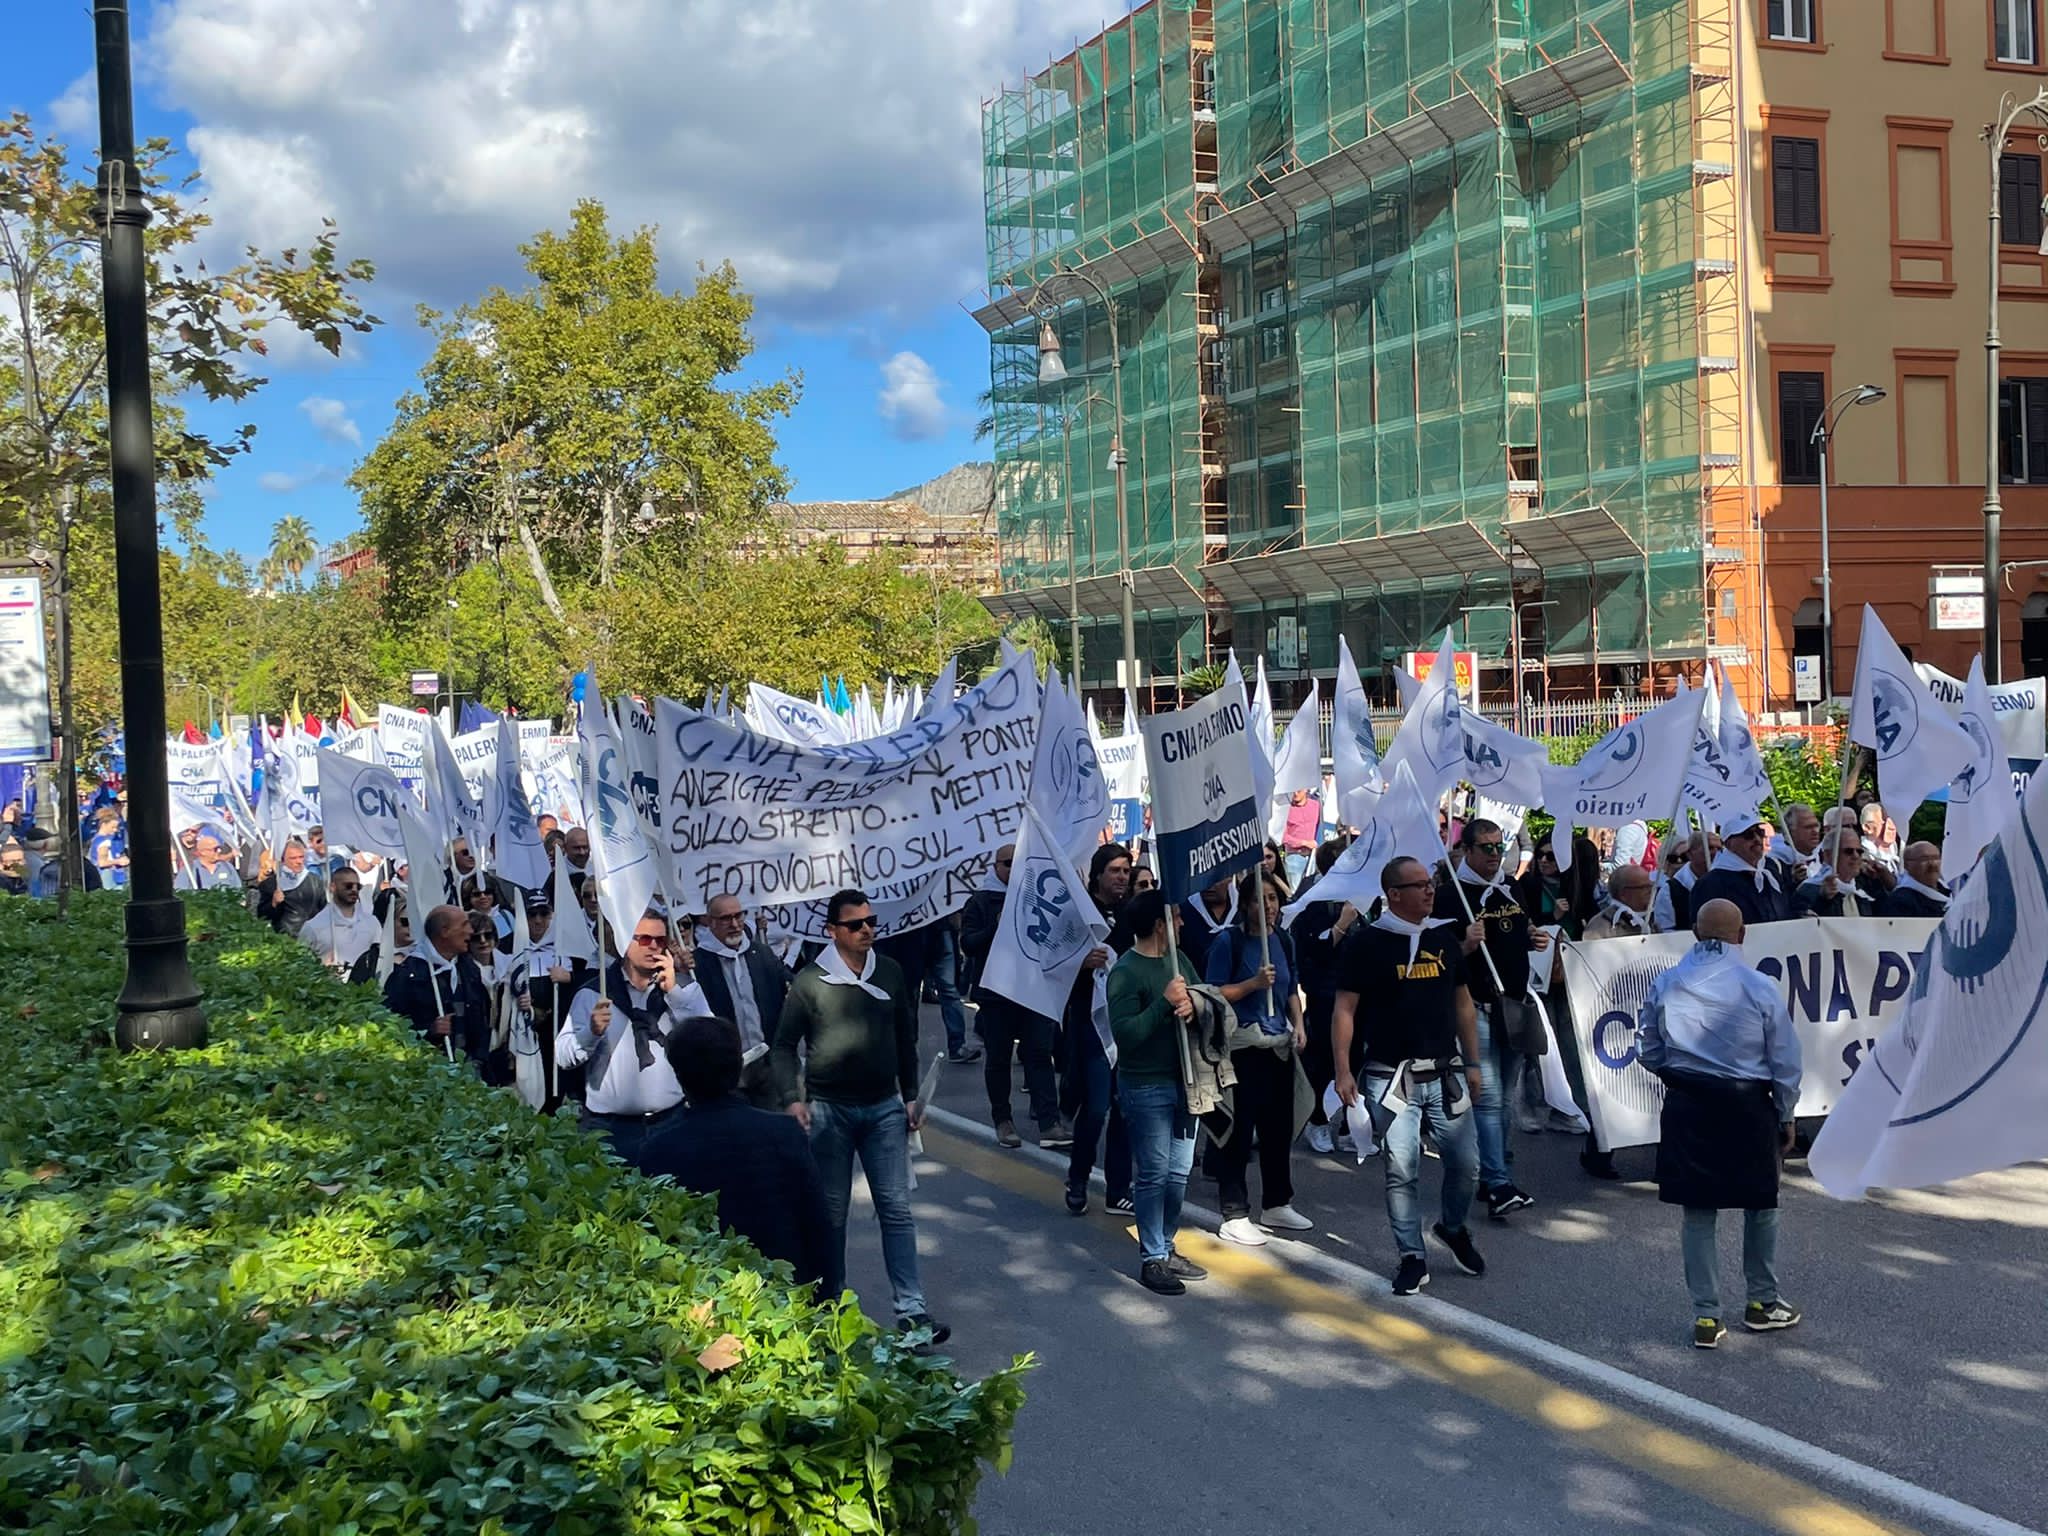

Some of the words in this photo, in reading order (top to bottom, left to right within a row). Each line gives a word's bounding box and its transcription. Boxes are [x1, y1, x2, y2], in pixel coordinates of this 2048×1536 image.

[776, 704, 825, 729] CNA
[1989, 689, 2036, 712] ERMO
[384, 712, 405, 729] CNA
[407, 717, 423, 734] PAL
[521, 726, 548, 740] ERMO
[1160, 726, 1198, 764] CNA
[1199, 702, 1246, 752] PALERMO
[675, 715, 804, 772] CNA
[356, 786, 399, 820] CN
[1203, 773, 1227, 807] CNA
[288, 799, 322, 824] CN
[671, 812, 749, 853] SULLO
[695, 843, 897, 905] FOTOVOLTAICO
[901, 829, 963, 869] SUL
